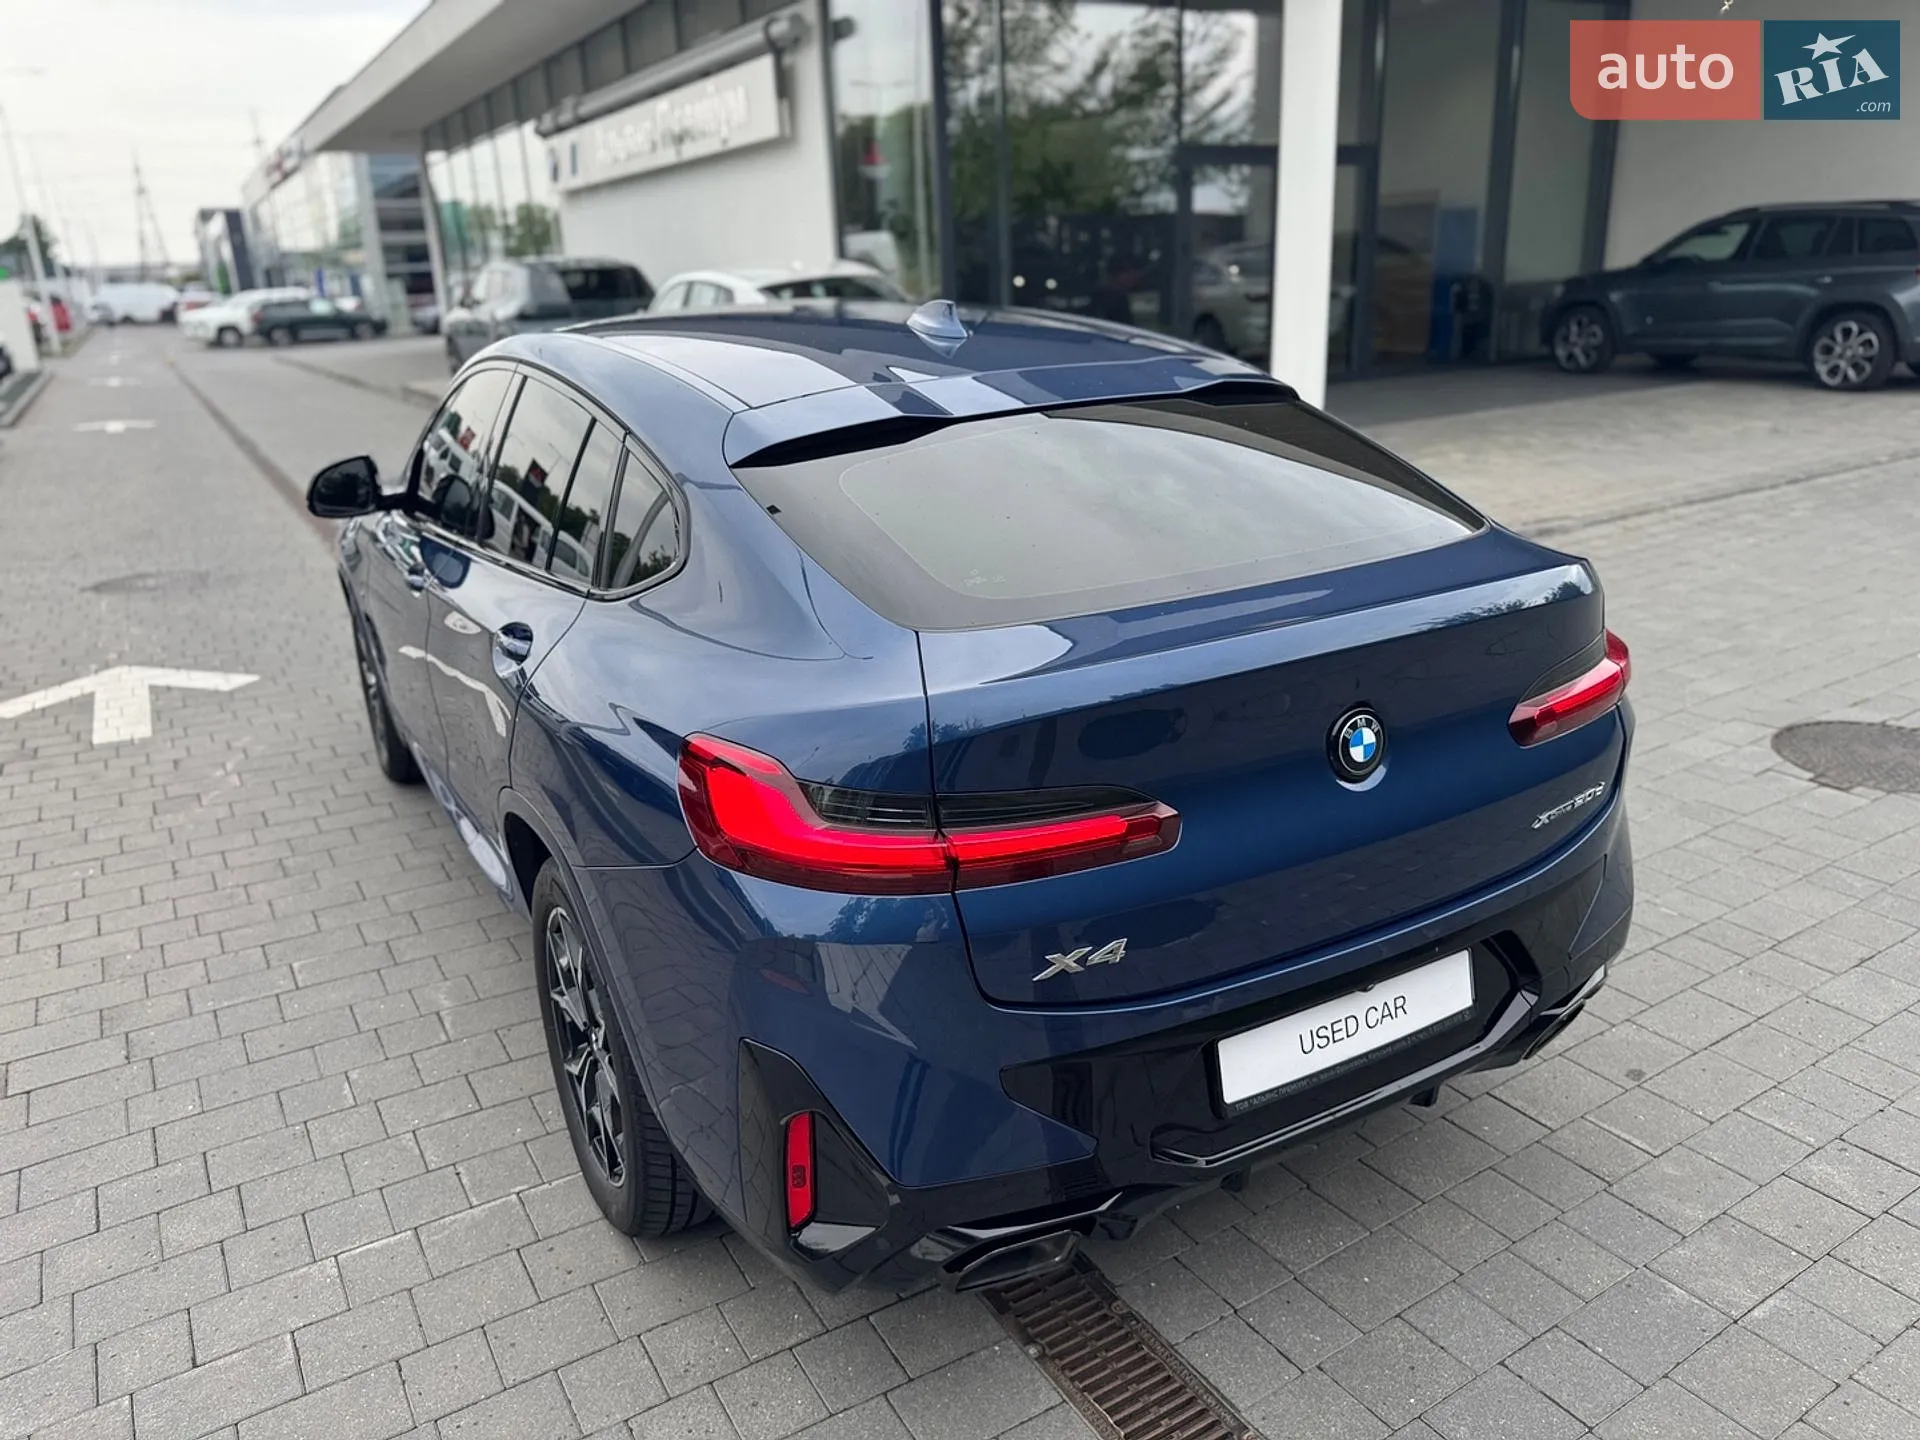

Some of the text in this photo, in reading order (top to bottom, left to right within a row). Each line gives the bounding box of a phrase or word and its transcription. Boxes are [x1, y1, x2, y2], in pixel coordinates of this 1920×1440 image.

[1343, 716, 1380, 740] BMW
[1032, 937, 1128, 982] X4
[1299, 1014, 1360, 1055] USED
[1364, 995, 1408, 1030] CAR
